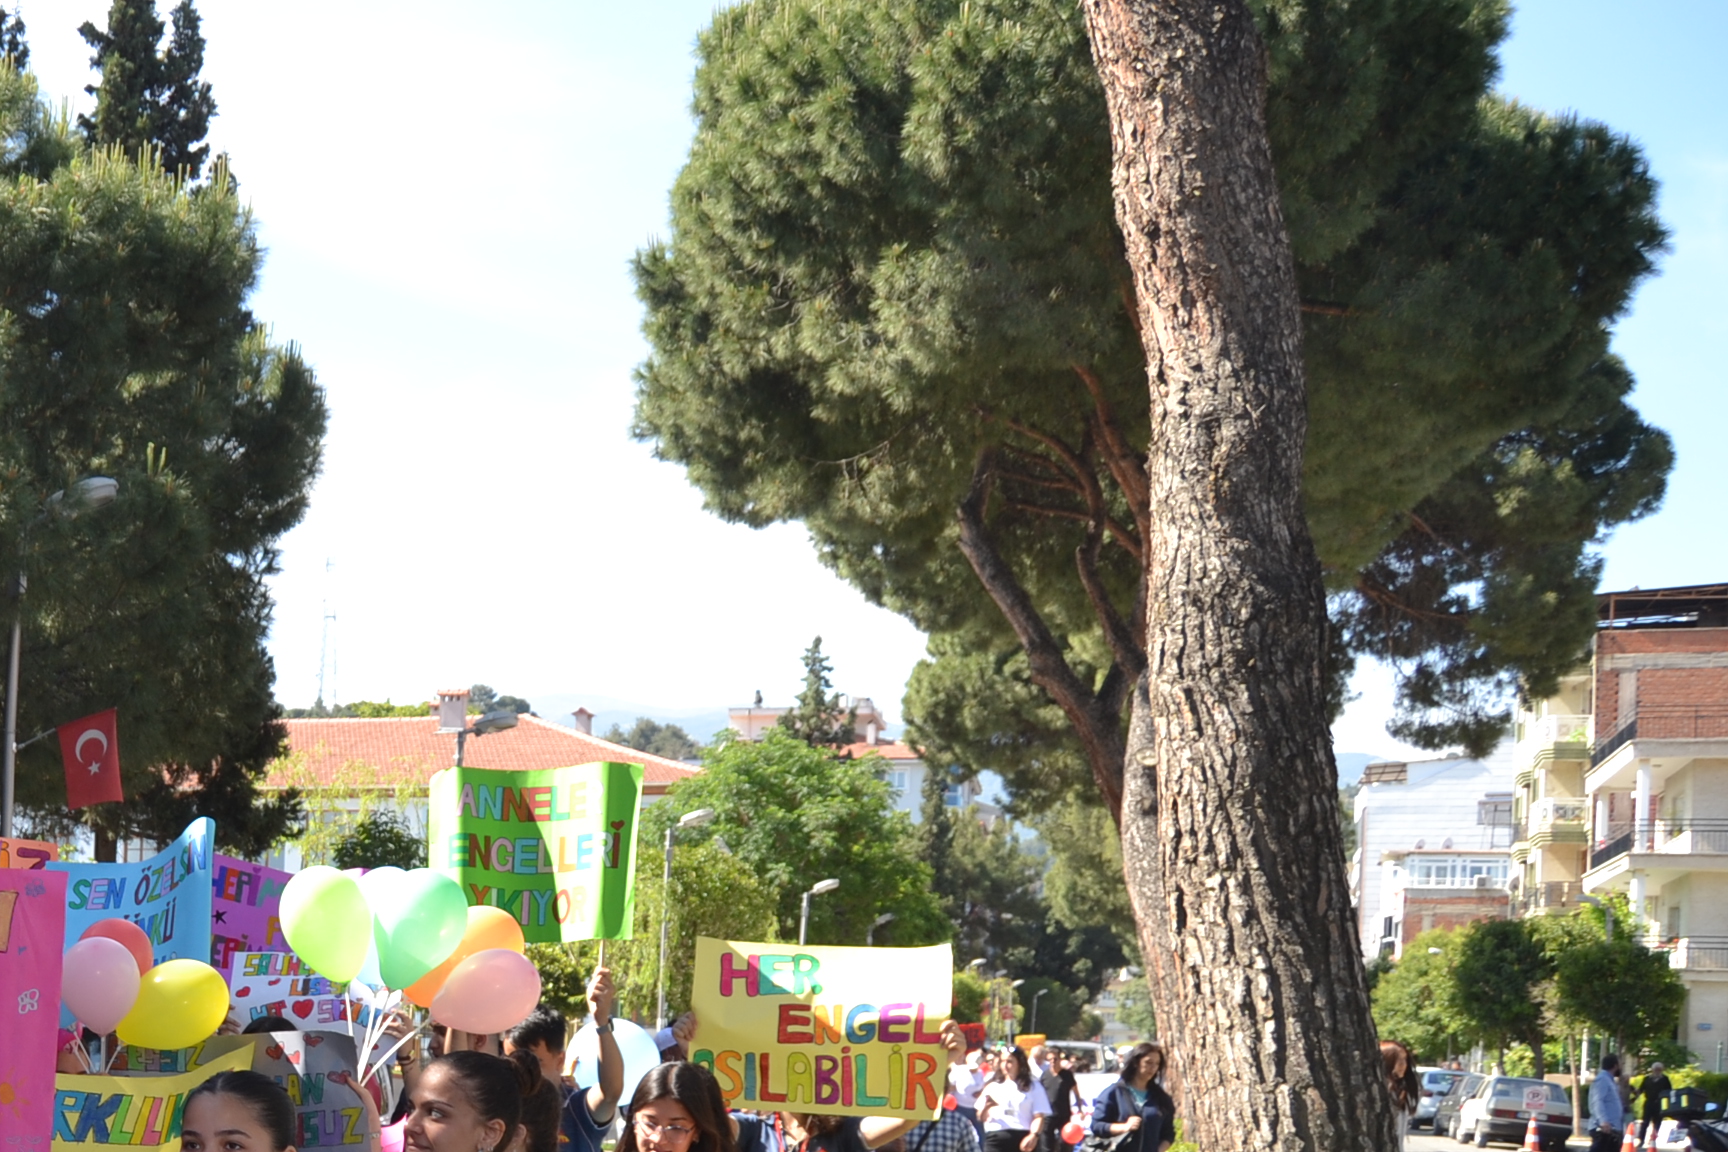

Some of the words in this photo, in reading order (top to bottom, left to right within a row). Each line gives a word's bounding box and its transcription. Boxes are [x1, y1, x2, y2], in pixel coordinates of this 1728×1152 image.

[457, 780, 603, 822] ANNELER
[448, 820, 625, 874] ENGELLERİ
[69, 877, 126, 910] SEN
[134, 833, 207, 906] ÖZELSİN
[777, 1002, 942, 1045] ENGEL
